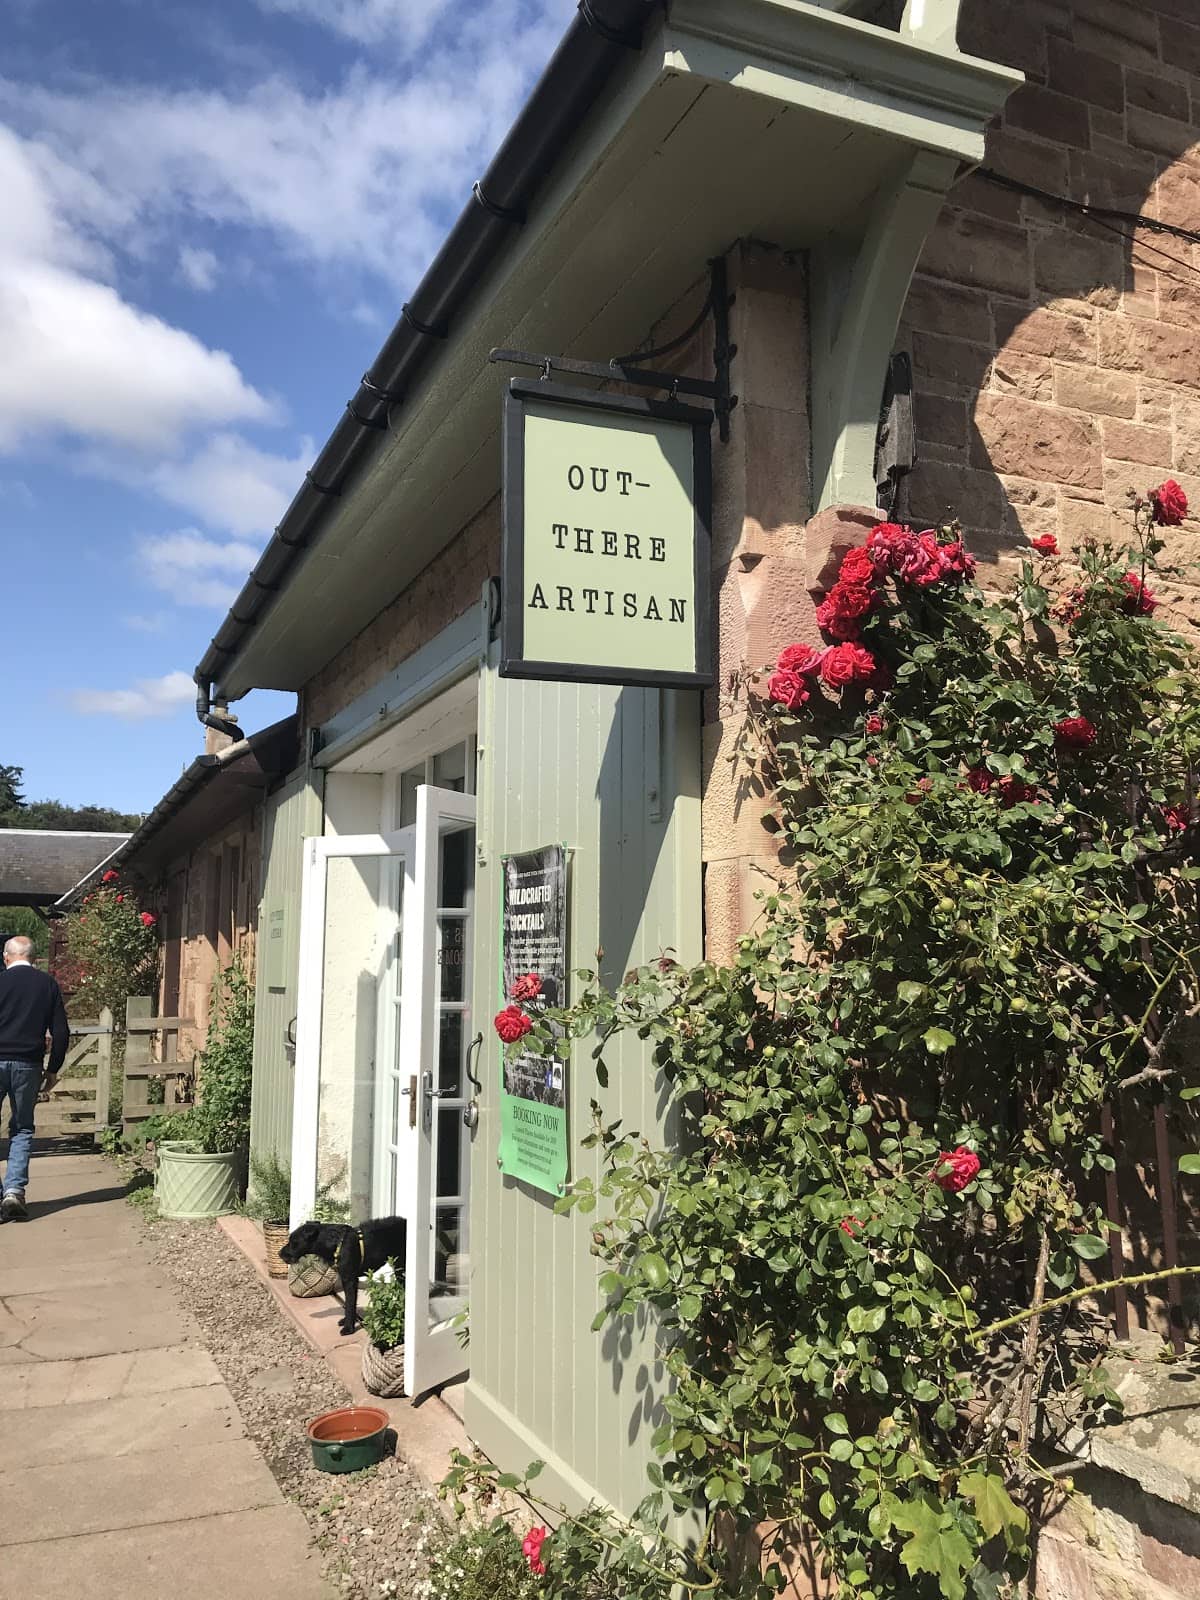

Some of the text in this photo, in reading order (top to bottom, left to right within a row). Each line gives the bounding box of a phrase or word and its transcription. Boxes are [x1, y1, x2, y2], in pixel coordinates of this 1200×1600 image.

[568, 464, 650, 496] OUT-
[552, 523, 666, 562] THERE
[527, 583, 687, 623] ARTISAN
[509, 885, 551, 906] WILDCRAFTED
[510, 912, 545, 931] COCKTAILS
[513, 1105, 560, 1132] BOOKING NOW
